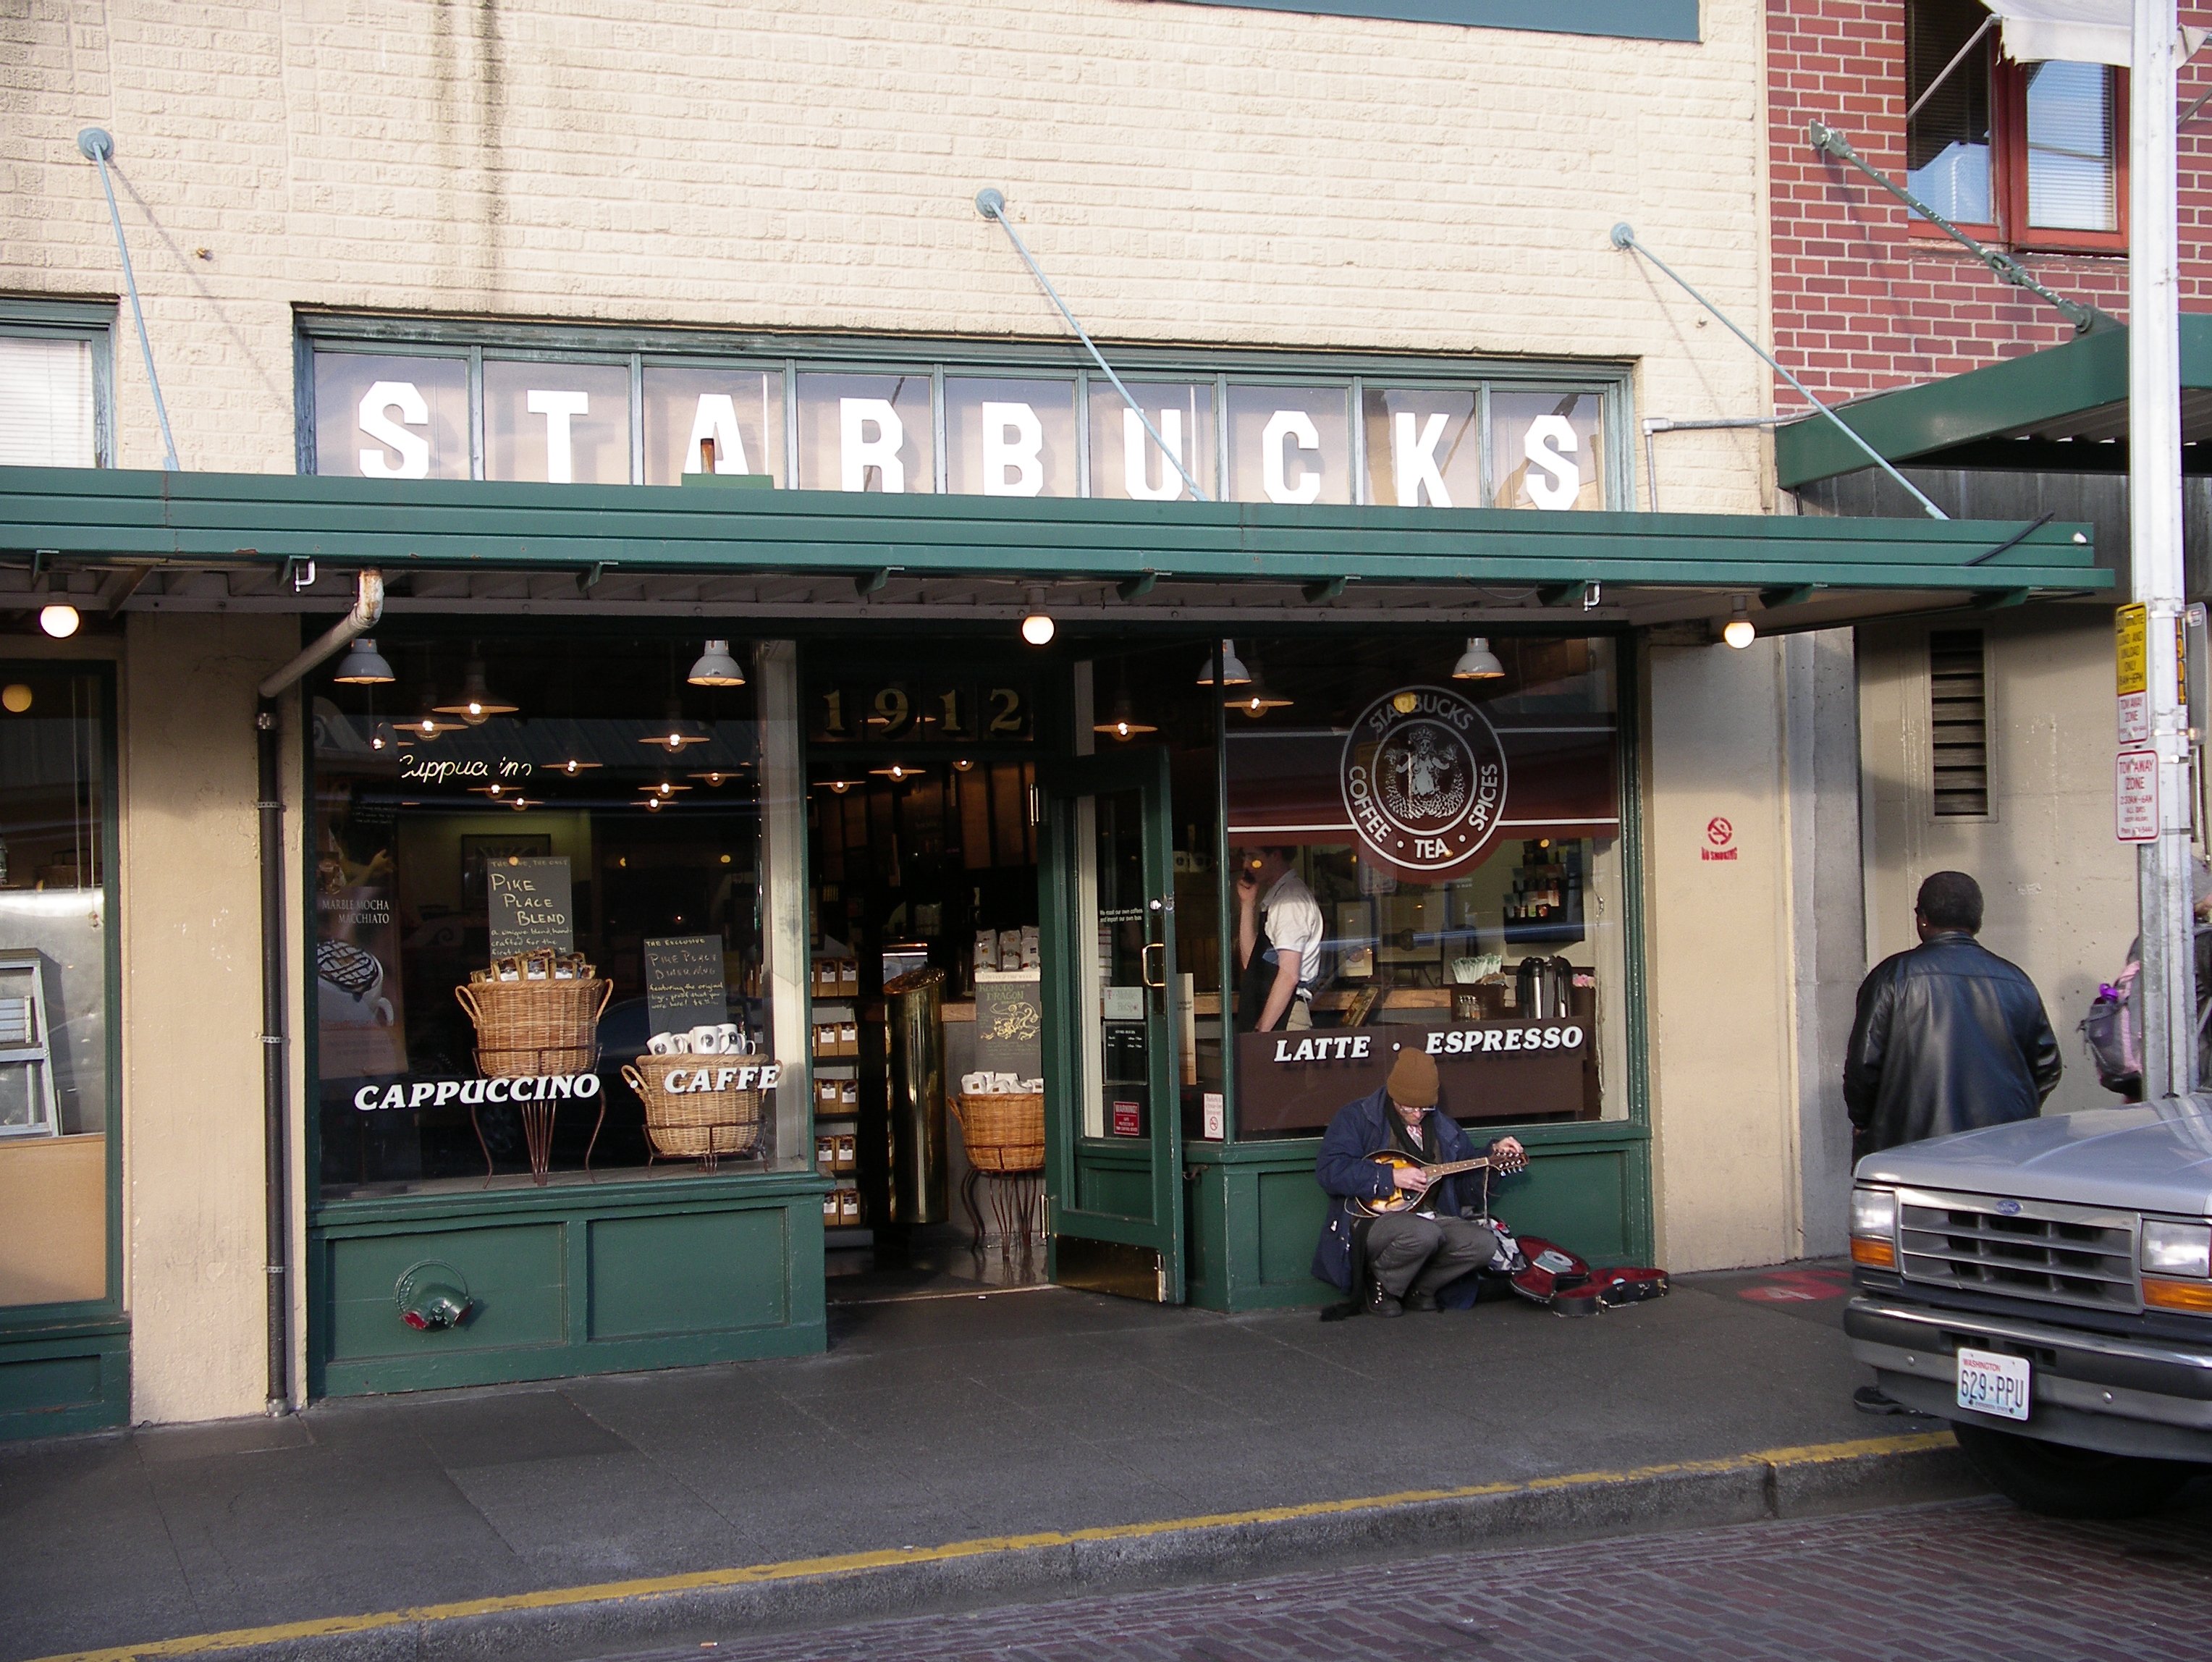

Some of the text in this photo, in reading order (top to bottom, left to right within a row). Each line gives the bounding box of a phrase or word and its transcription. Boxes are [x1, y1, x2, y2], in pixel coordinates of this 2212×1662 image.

[358, 381, 1580, 511] STARBUCKS
[823, 688, 1022, 733] 1912
[1369, 693, 1474, 734] STABUCKS
[2119, 759, 2154, 774] TOW AWAY
[2125, 776, 2145, 790] ZONE
[1348, 765, 1392, 843] COFFEE
[1468, 763, 1498, 832] SPICES
[1414, 838, 1448, 859] TEA
[490, 873, 536, 891] PIKE
[322, 899, 389, 910] MARBLE MOCHA
[502, 893, 554, 908] PLACE
[338, 914, 389, 924] MACCHIATO
[517, 911, 565, 927] BLEND
[491, 938, 523, 947] crafted
[647, 950, 716, 966] PIKE PLACE
[649, 984, 685, 994] featuring
[979, 984, 1014, 992] KOMODO
[987, 990, 1024, 1001] DRAGON
[1424, 1026, 1584, 1055] ESPRESSO
[1273, 1037, 1372, 1063] LATTE
[664, 1066, 780, 1094] CAFFE
[354, 1073, 601, 1110] CAPPUCCINO
[1963, 1358, 2001, 1372] WASHINGTON
[1962, 1369, 2024, 1408] 629-PPU
